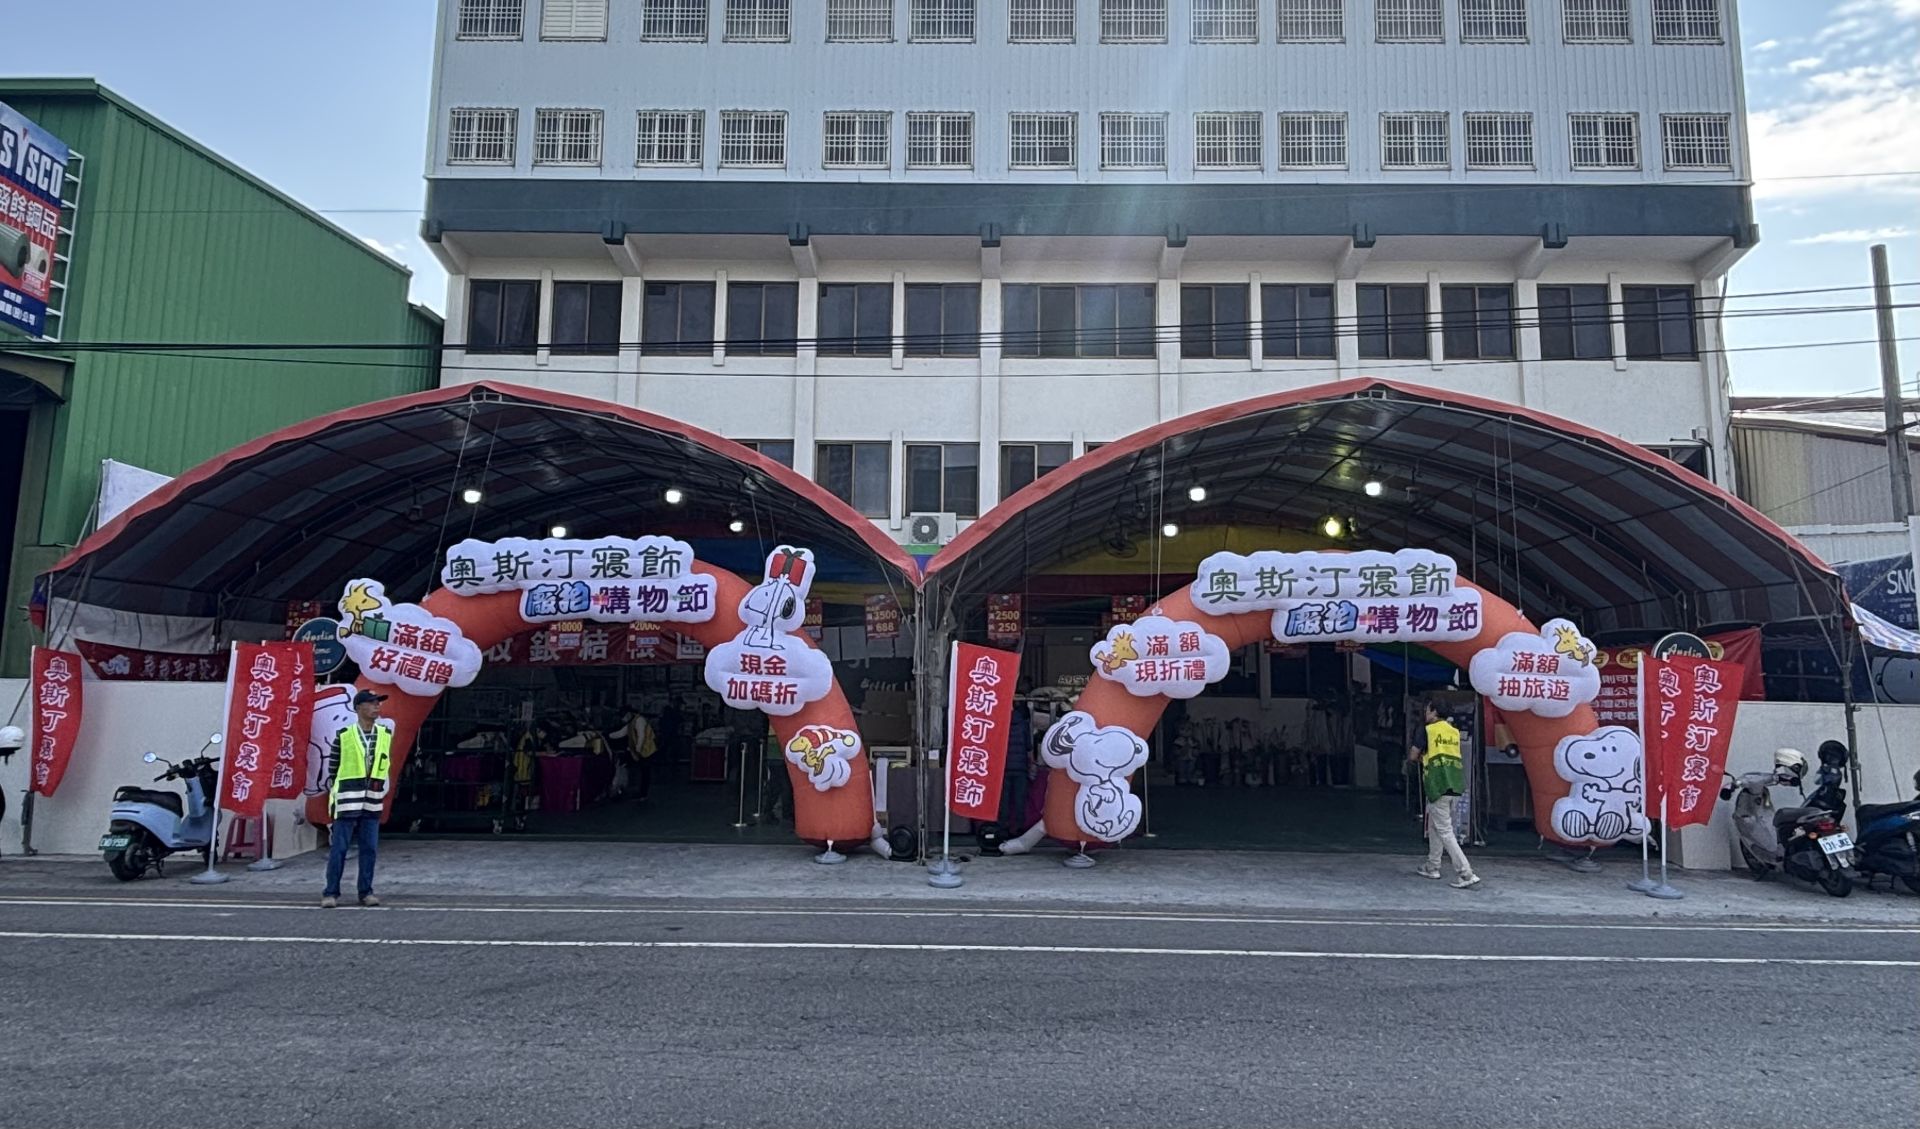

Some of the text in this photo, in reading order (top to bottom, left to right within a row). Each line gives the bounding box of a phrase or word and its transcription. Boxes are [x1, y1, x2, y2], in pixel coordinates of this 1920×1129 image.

[446, 545, 683, 588] 奧斯汀寢飾
[1201, 563, 1451, 603] 奧斯汀寢飾
[558, 621, 583, 632] 10000
[872, 610, 897, 620] 3500
[995, 610, 1020, 621] 2500
[998, 622, 1018, 632] 250
[393, 622, 450, 656] 滿額
[1146, 632, 1201, 657] 滿額
[369, 646, 454, 686] 好禮贈
[740, 653, 788, 676] 現金
[1135, 659, 1206, 682] 現折禮
[1511, 651, 1561, 674] 滿額
[727, 678, 798, 705] 加碼折
[1497, 676, 1571, 701] 抽旅遊
[955, 655, 1001, 808] 奧斯汀寢飾
